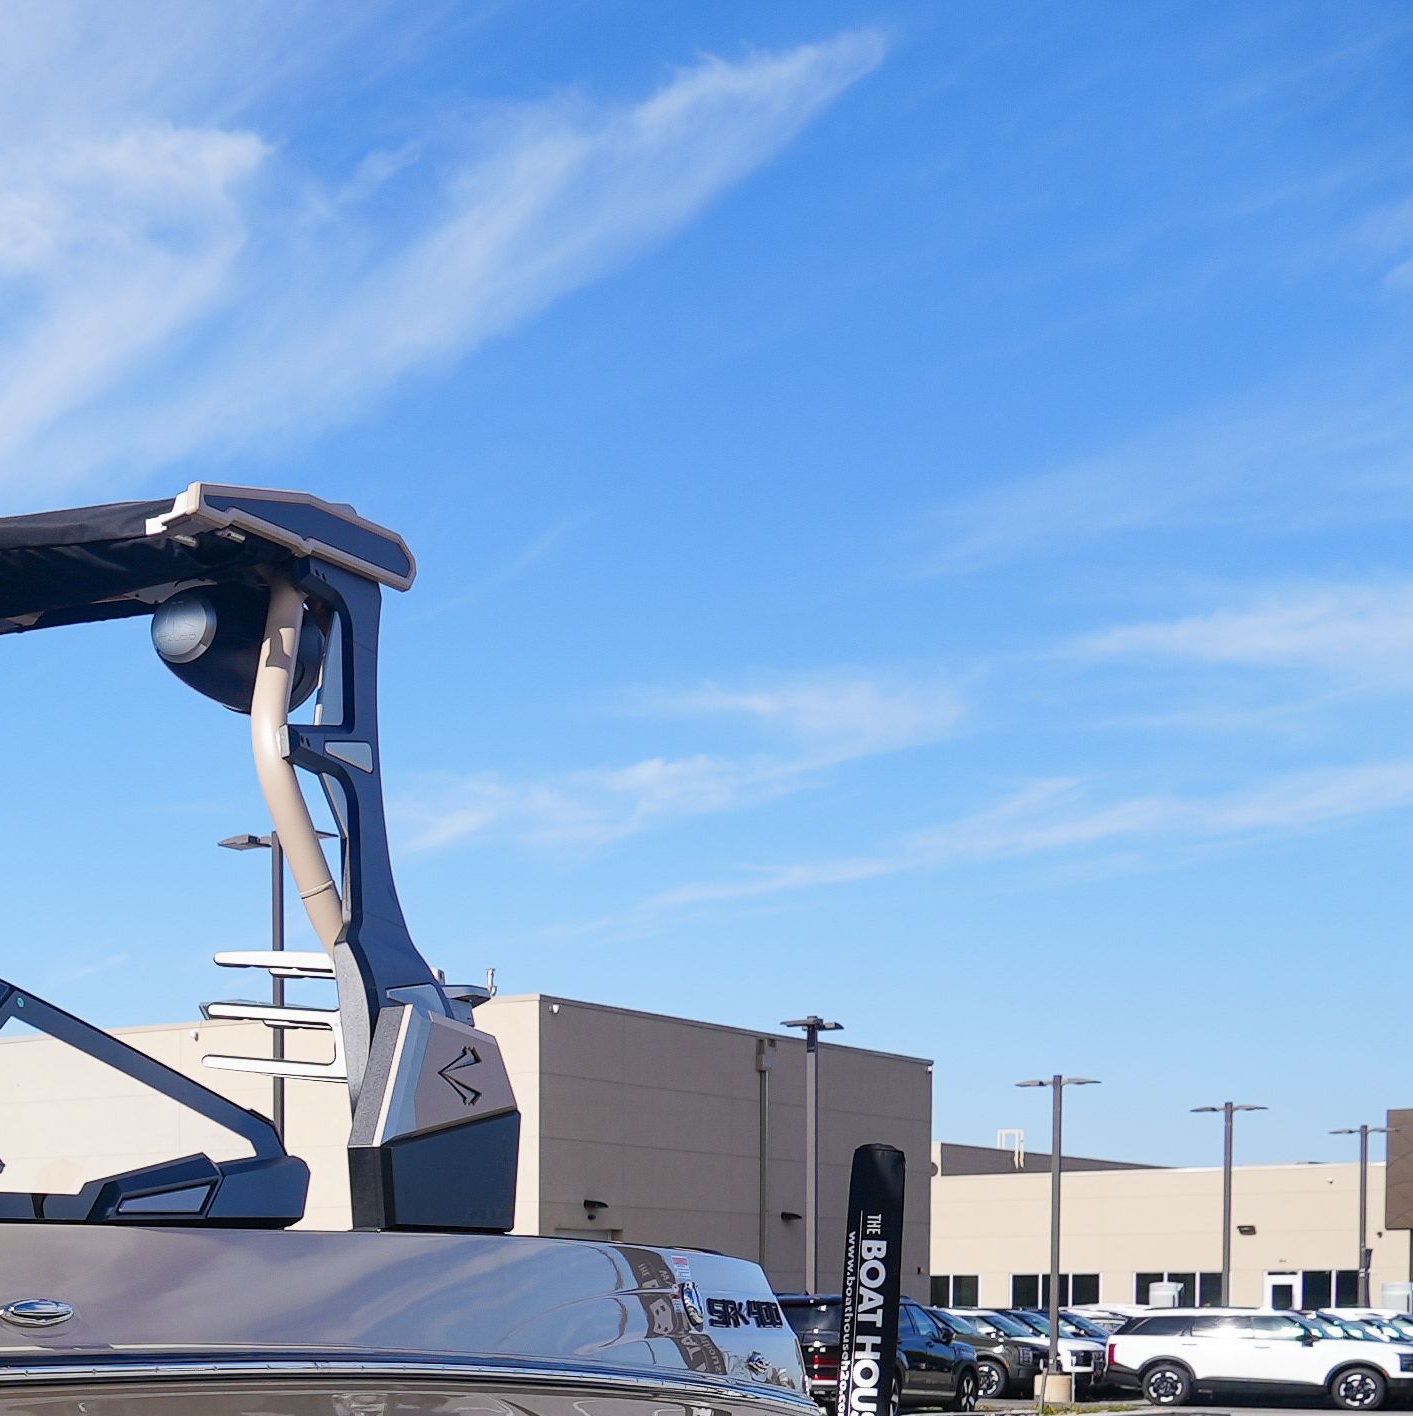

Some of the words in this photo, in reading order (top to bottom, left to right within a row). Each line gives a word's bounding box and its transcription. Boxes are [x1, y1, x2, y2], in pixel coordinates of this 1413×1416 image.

[866, 1213, 882, 1235] THE
[857, 1240, 887, 1328] BOAT
[706, 1298, 750, 1328] SRK
